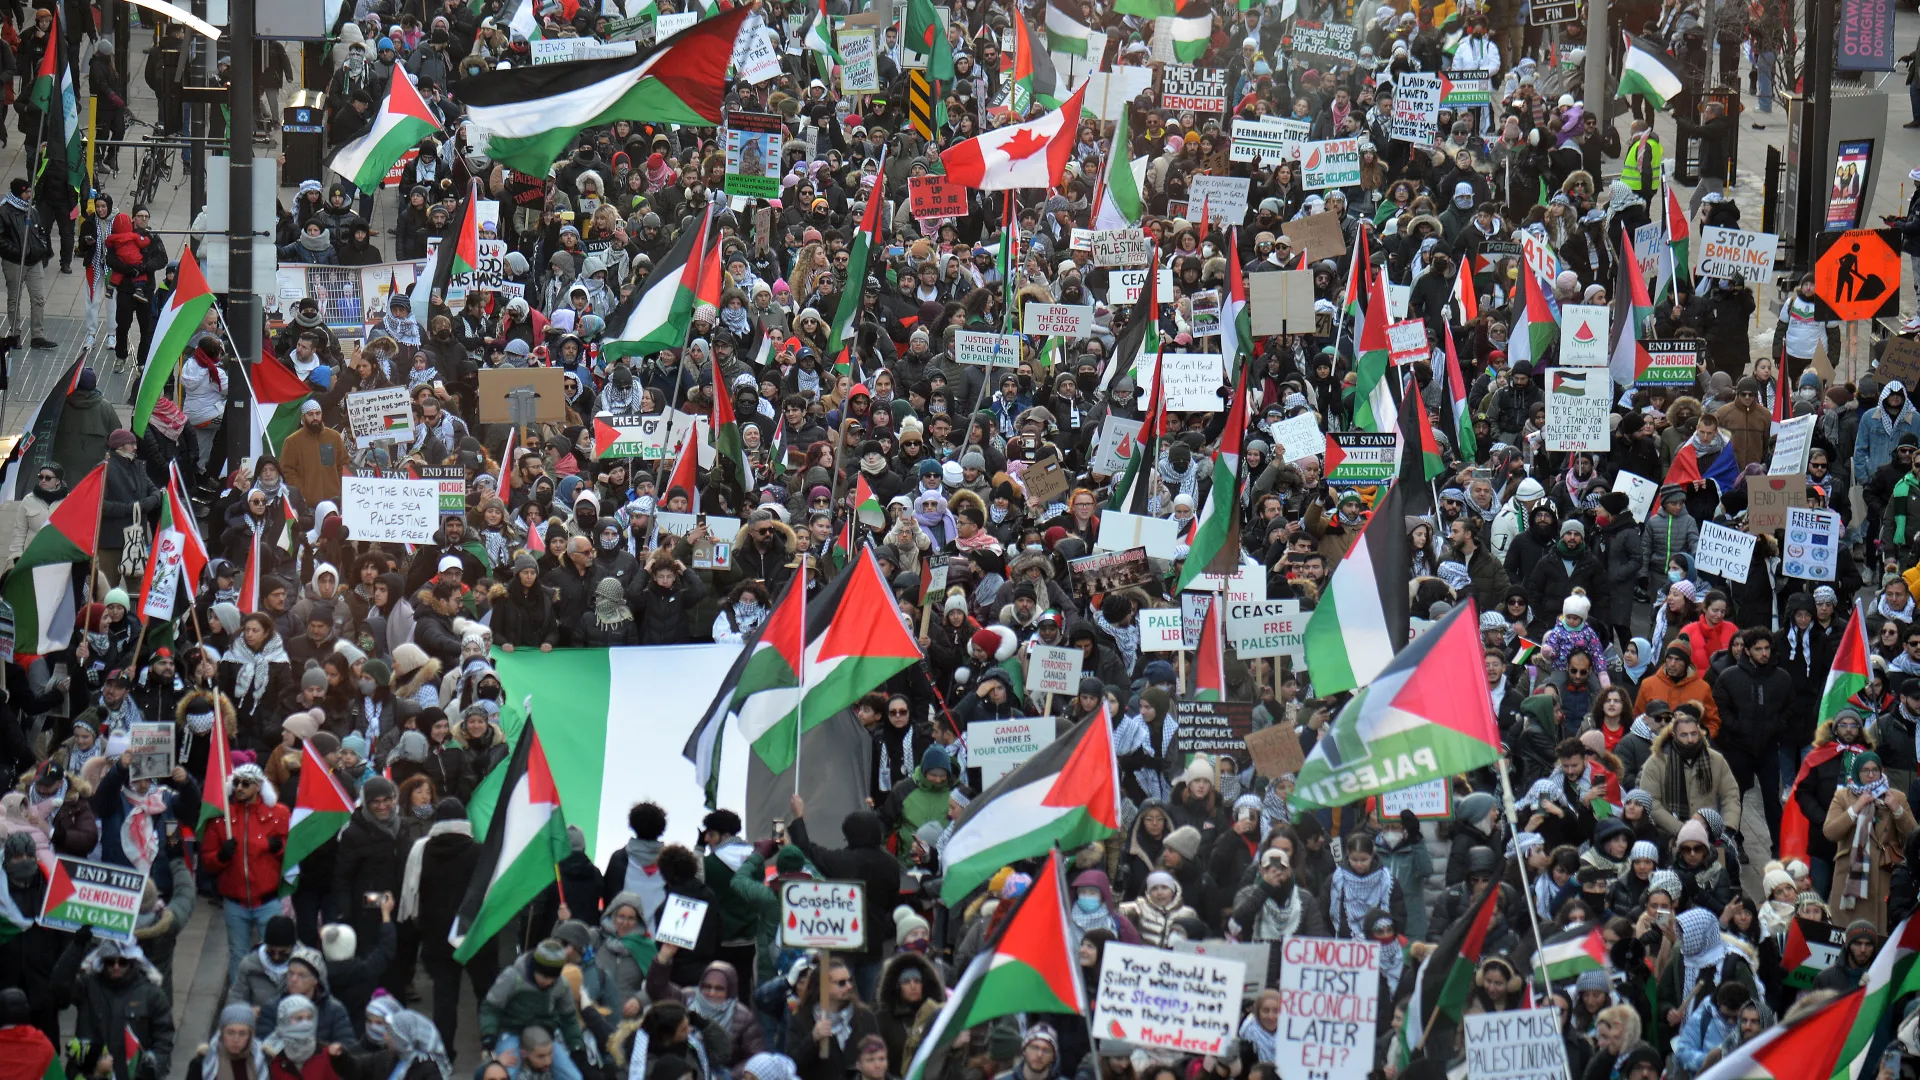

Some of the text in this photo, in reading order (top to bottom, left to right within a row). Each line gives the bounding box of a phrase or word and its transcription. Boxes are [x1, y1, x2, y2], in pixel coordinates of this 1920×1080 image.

[1546, 8, 1563, 20] FIN
[1874, 0, 1886, 57] DOWNTO
[538, 43, 566, 53] JEWS
[750, 47, 769, 61] FREE
[1164, 67, 1194, 81] THEY
[1448, 72, 1461, 80] WE
[1164, 80, 1178, 93] TO
[1402, 76, 1441, 90] LAND YOU
[1425, 103, 1433, 111] IS
[1236, 128, 1283, 141] PERMANENT
[1340, 142, 1356, 150] THE
[1235, 146, 1281, 159] CEASEFIRE
[1326, 153, 1357, 163] APARTHEID
[911, 176, 940, 188] TO NOT
[1326, 170, 1360, 183] OCCUPATION
[932, 186, 942, 194] UP
[916, 195, 958, 206] IS TO BE
[915, 206, 961, 217] COMPLICIT
[1636, 229, 1659, 243] MEDIA
[1716, 231, 1755, 248] STOP
[1094, 242, 1146, 255] PALESTINE
[1706, 244, 1769, 265] BOMBING
[1116, 256, 1125, 264] BE
[1701, 259, 1766, 282] CHILDREN!
[451, 273, 502, 287] HIS HANDS
[1050, 308, 1068, 316] END
[1037, 315, 1080, 325] THE SIEGE
[1039, 324, 1077, 333] OF GAZA
[964, 336, 993, 344] JUSTICE
[960, 344, 1014, 356] THE CHILREN
[1648, 342, 1696, 351] END THE
[961, 353, 1014, 365] OF PALESTINE!
[1656, 354, 1695, 366] GENOCIDE
[1648, 370, 1693, 379] IN GAZA
[1185, 387, 1197, 395] Not
[378, 394, 394, 402] have
[1554, 396, 1609, 407] YOU DON'T NEED
[382, 401, 410, 411] not yours
[1552, 407, 1608, 418] TO BE MUSLIM
[613, 416, 639, 426] FREE
[1278, 417, 1317, 436] BOMBING
[1554, 417, 1562, 425] TO
[1567, 417, 1588, 425] STAND
[355, 429, 368, 437] DIE
[1340, 436, 1395, 445] WE STAND
[1560, 441, 1588, 450] HUMAN.
[1350, 452, 1378, 460] WITH
[357, 470, 374, 478] WE
[422, 468, 464, 477] END THE
[1337, 467, 1393, 476] PALESTINE
[350, 484, 434, 498] FROM THE RIVER
[1755, 492, 1804, 506] END THE
[357, 500, 421, 511] TO THE SEA
[370, 512, 428, 528] PALESTINE
[1793, 512, 1816, 521] FREE
[1792, 520, 1830, 531] PALESTINE
[358, 528, 429, 543] WILL BE FREE!
[1704, 525, 1755, 547] HUMANITY
[1701, 539, 1741, 557] BEFORE
[1074, 551, 1145, 573] SAVE CHILDREN
[1698, 554, 1746, 578] POLITICS!
[1232, 605, 1283, 619] CEASE
[1264, 622, 1292, 634] FREE
[1048, 651, 1066, 661] ISRAEL
[1042, 660, 1072, 671] TERRORISTE
[1044, 670, 1066, 680] CANADA
[1040, 680, 1067, 691] COMPLICE
[1178, 704, 1193, 713] NOT
[1178, 716, 1193, 725] NOT
[996, 725, 1030, 734] CANADA
[1178, 728, 1193, 738] NOT
[994, 735, 1032, 744] WHERE IS
[1178, 740, 1246, 750] NOT COMPLICATED
[974, 746, 996, 756] YOUR
[76, 866, 143, 890] END THE
[78, 887, 136, 909] GENOCIDE
[786, 885, 855, 912] Ceasefire
[675, 899, 699, 911] FREE
[66, 905, 129, 930] IN GAZA
[800, 919, 844, 936] NOW
[658, 933, 693, 949] PALESTINE
[1284, 938, 1379, 970] GENOCIDE
[1122, 958, 1228, 985] You Should be
[1105, 972, 1179, 991] Silent when
[1301, 968, 1360, 995] FIRST
[1103, 987, 1223, 1013] Are Sleeping, not
[1279, 989, 1378, 1023] RECONCILE
[1101, 1005, 1230, 1036] when they're being
[1287, 1018, 1359, 1047] LATER
[1465, 1016, 1558, 1044] WHY MUS
[1141, 1026, 1222, 1052] Murdered
[1468, 1041, 1564, 1074] PALESTINIANS
